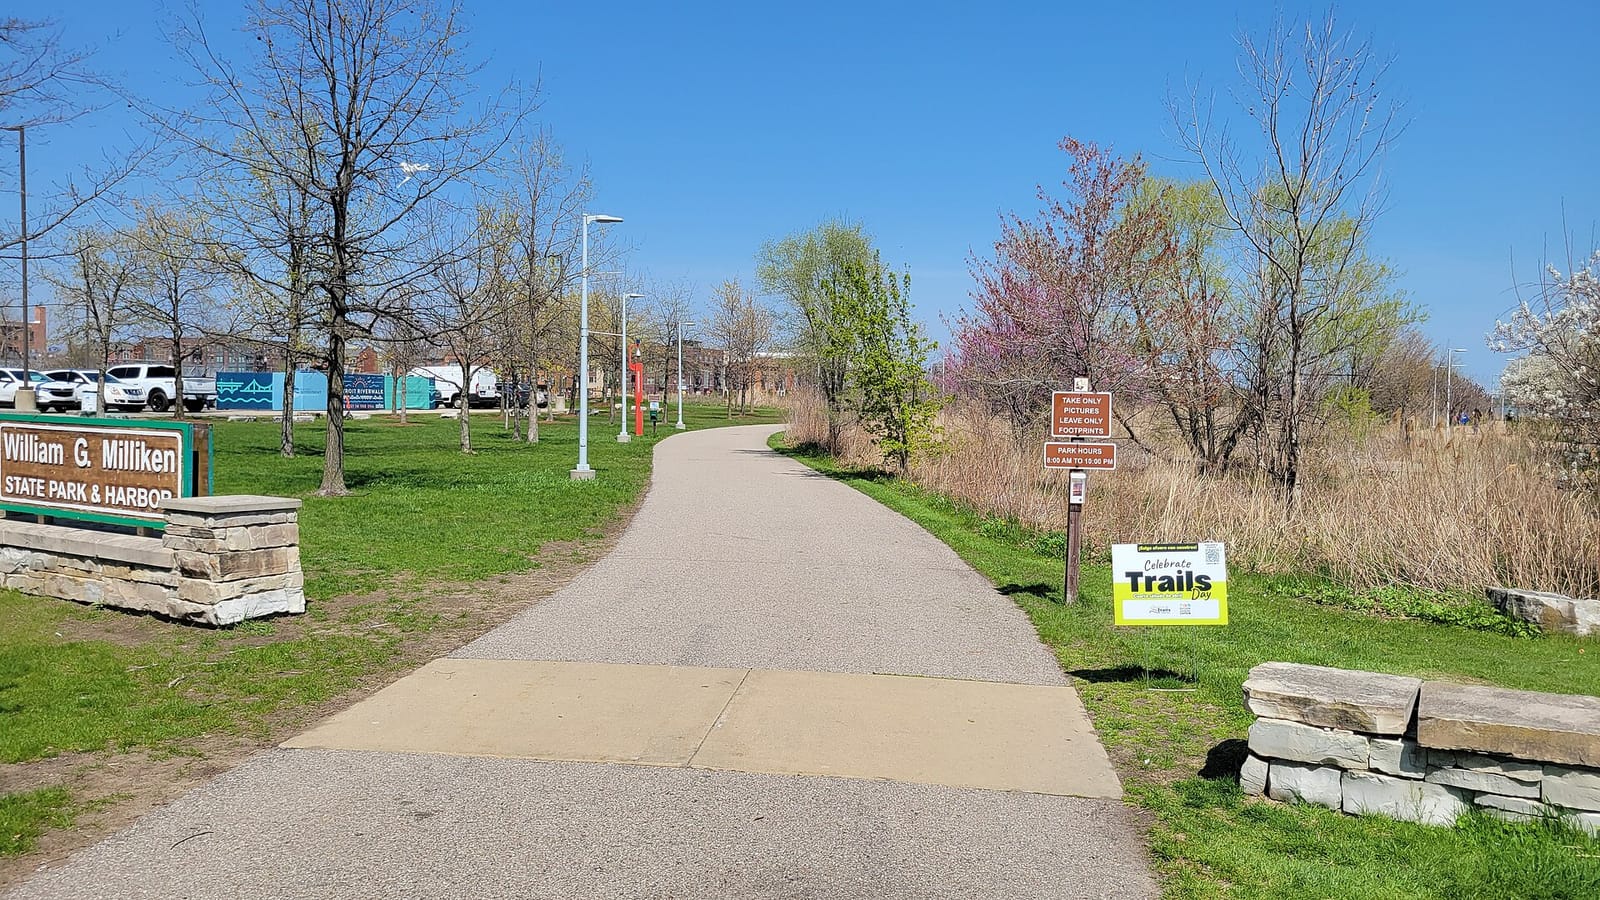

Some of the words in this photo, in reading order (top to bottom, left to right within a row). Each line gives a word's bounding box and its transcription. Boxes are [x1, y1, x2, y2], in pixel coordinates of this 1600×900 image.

[1063, 407, 1100, 415] PICTURES
[1083, 417, 1103, 425] ONLY
[1058, 427, 1104, 435] FOOTPRINTS
[3, 432, 64, 465] William
[73, 437, 91, 467] G.
[102, 439, 175, 473] Milliken
[1078, 447, 1102, 455] HOURS
[5, 475, 46, 498] STATE
[49, 480, 87, 502] PARK
[91, 484, 101, 504] &
[1144, 558, 1192, 572] Celebrate
[1125, 569, 1212, 593] Trails
[1191, 588, 1212, 601] Day
